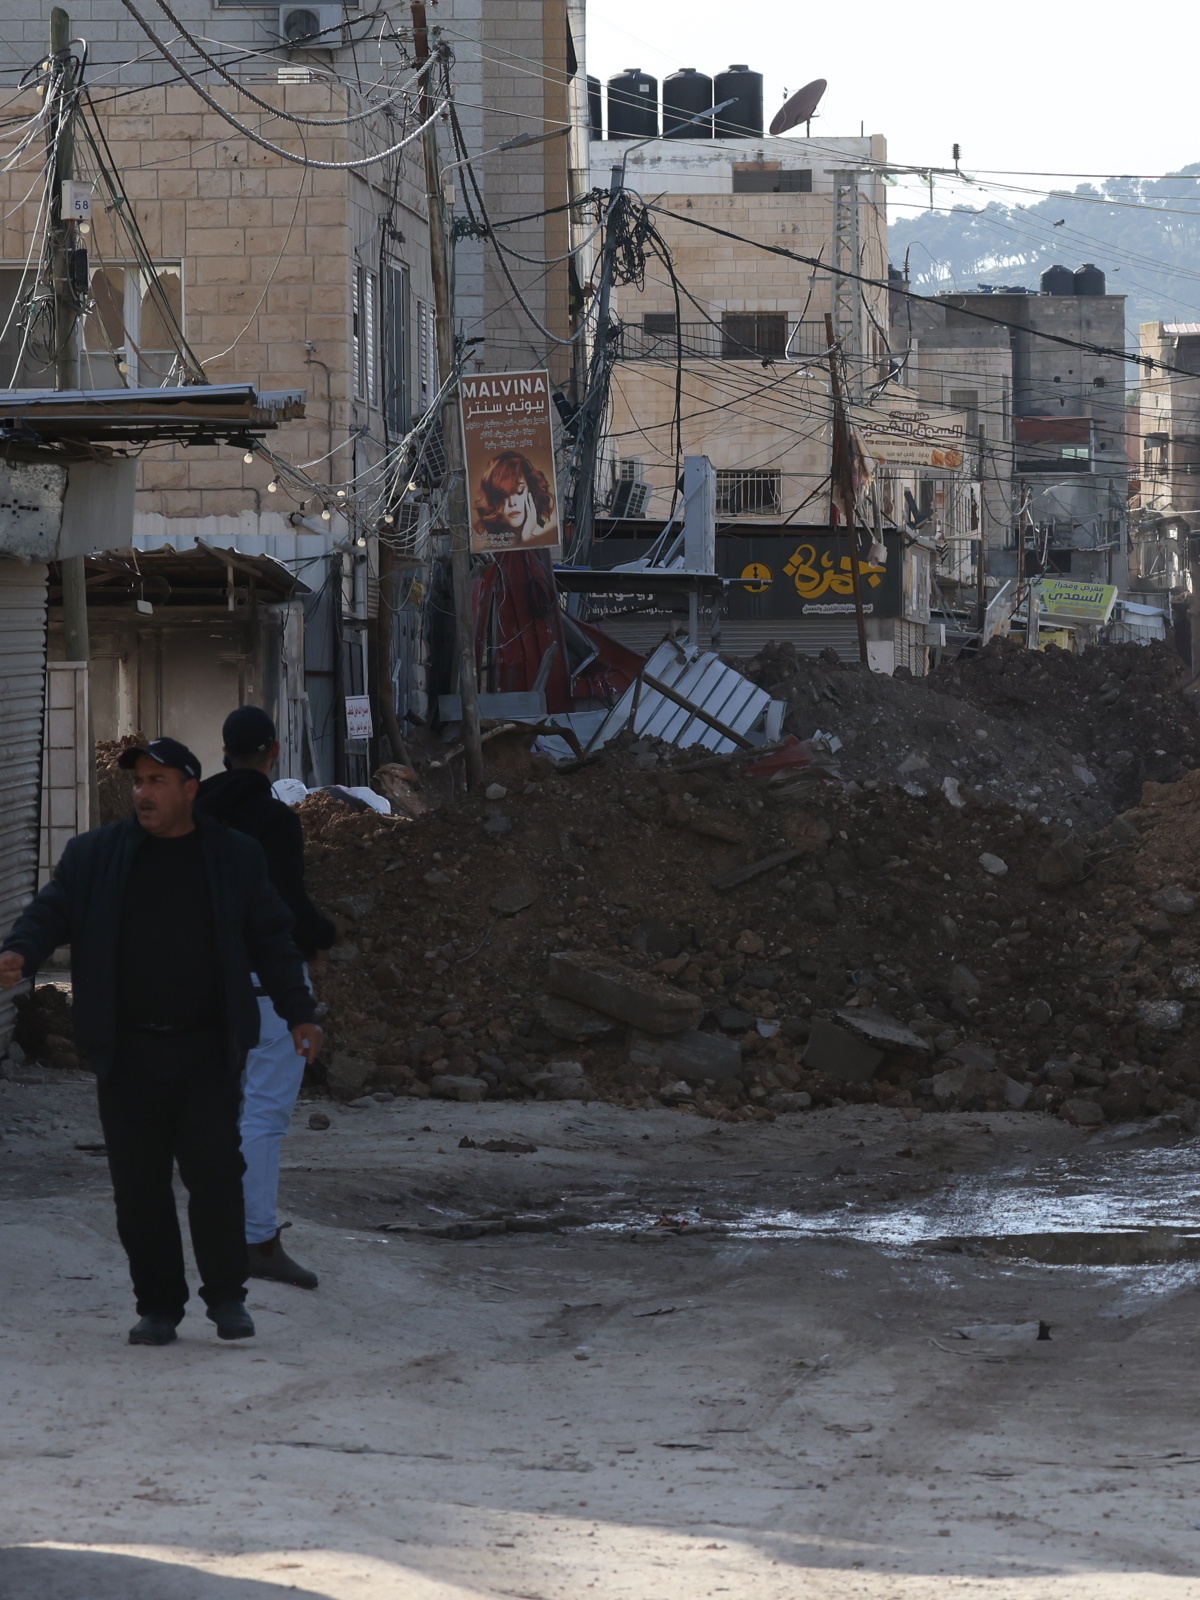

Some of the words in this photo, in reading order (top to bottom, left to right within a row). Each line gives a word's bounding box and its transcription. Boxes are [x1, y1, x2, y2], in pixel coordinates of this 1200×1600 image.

[74, 200, 89, 210] 58
[461, 377, 546, 399] MALVINA
[466, 401, 502, 419] سنتر
[505, 398, 545, 416] بيوتي
[913, 422, 963, 440] السوق
[1048, 592, 1104, 604] السعدي
